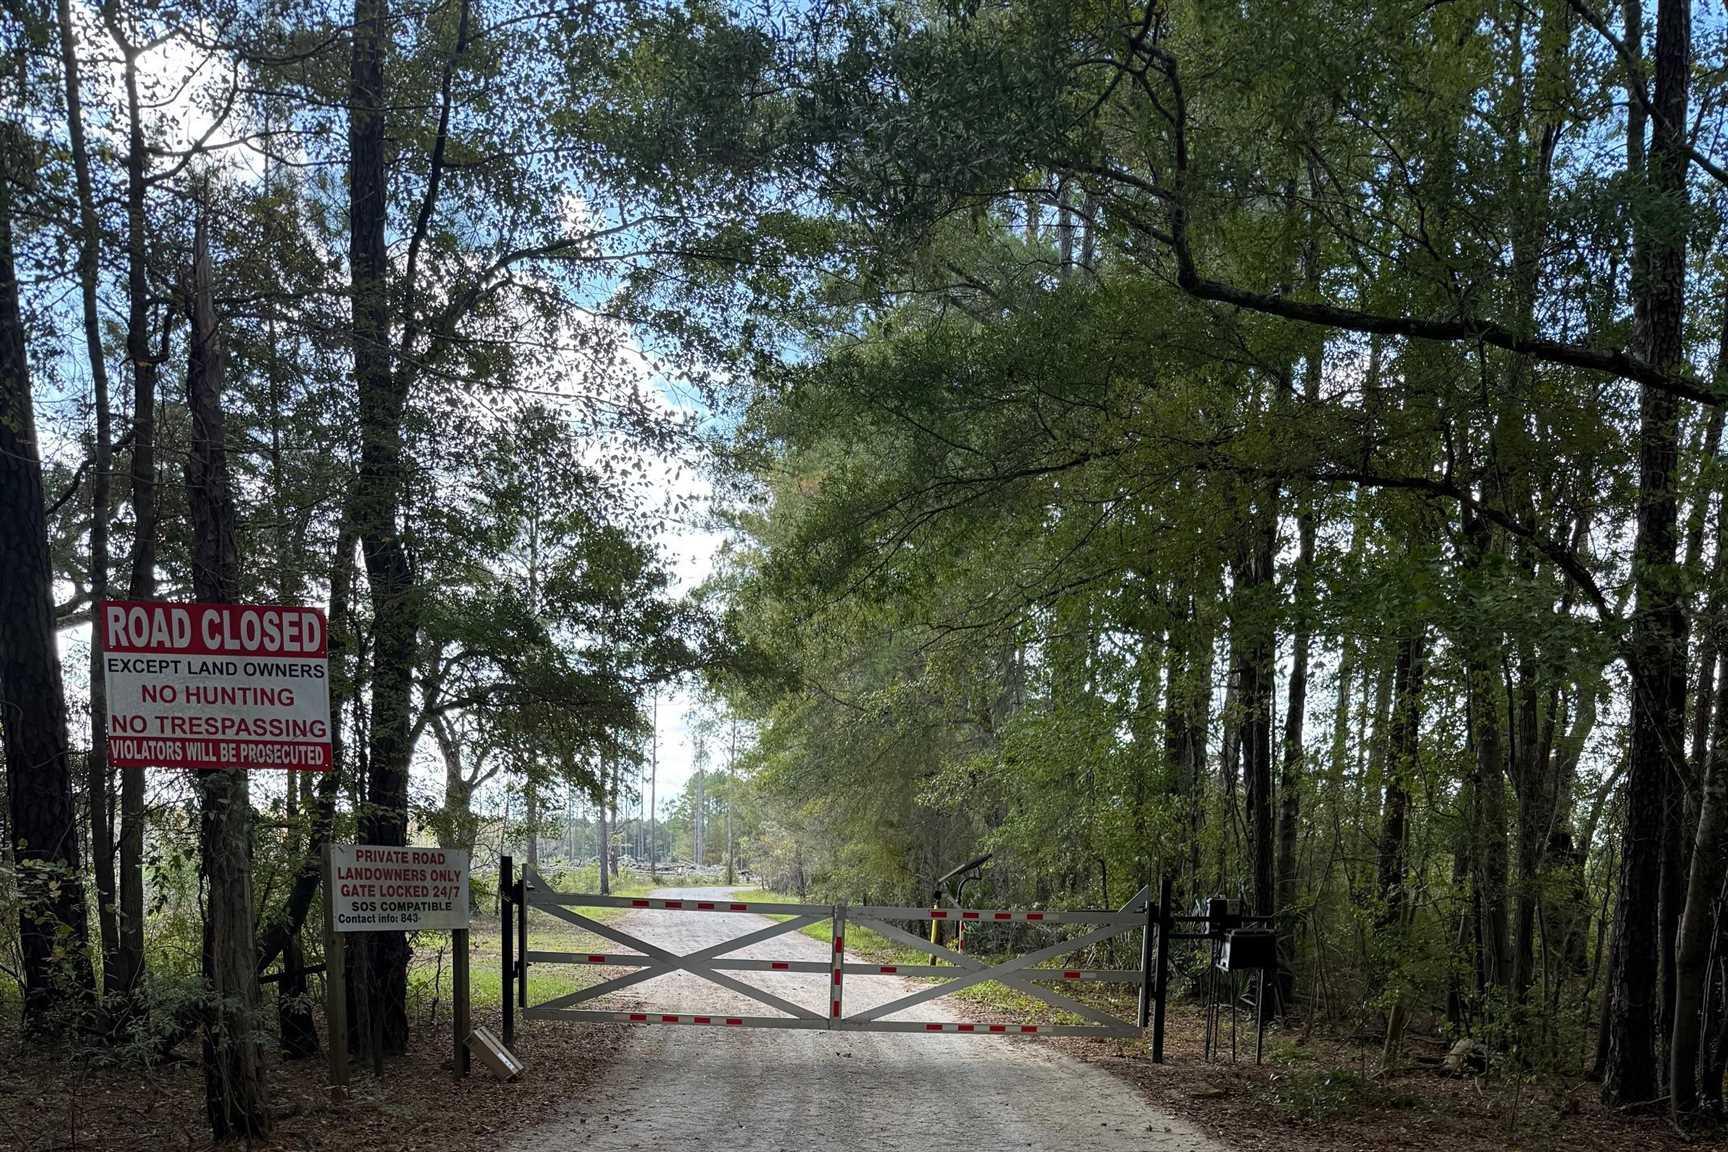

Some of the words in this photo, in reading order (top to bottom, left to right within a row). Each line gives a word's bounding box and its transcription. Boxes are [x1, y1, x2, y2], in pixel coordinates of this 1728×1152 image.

[107, 607, 191, 648] ROAD
[202, 609, 320, 652] CLOSED
[108, 659, 181, 674] EXCEPT
[187, 662, 237, 676] LAND
[243, 663, 324, 678] OWNERS
[141, 685, 176, 704] NO
[186, 686, 295, 706] HUNTING
[112, 715, 147, 733] NO
[155, 717, 326, 738] TRESPASSING
[111, 740, 182, 760] VIOLATORS
[186, 742, 216, 761] WILL
[221, 743, 236, 762] BE
[240, 744, 323, 765] PROSECUTED
[356, 850, 408, 863] PRIVATE
[413, 852, 445, 864] ROAD
[338, 867, 427, 881] LANDOWNERS
[431, 870, 461, 882] ONLY
[341, 884, 375, 897] GATE
[380, 885, 428, 897] LOCKED
[433, 886, 459, 900] 24/7
[352, 902, 376, 912] SOS
[380, 902, 452, 912] COMPATIBLE
[338, 914, 375, 923] Contact
[378, 914, 398, 923] info:
